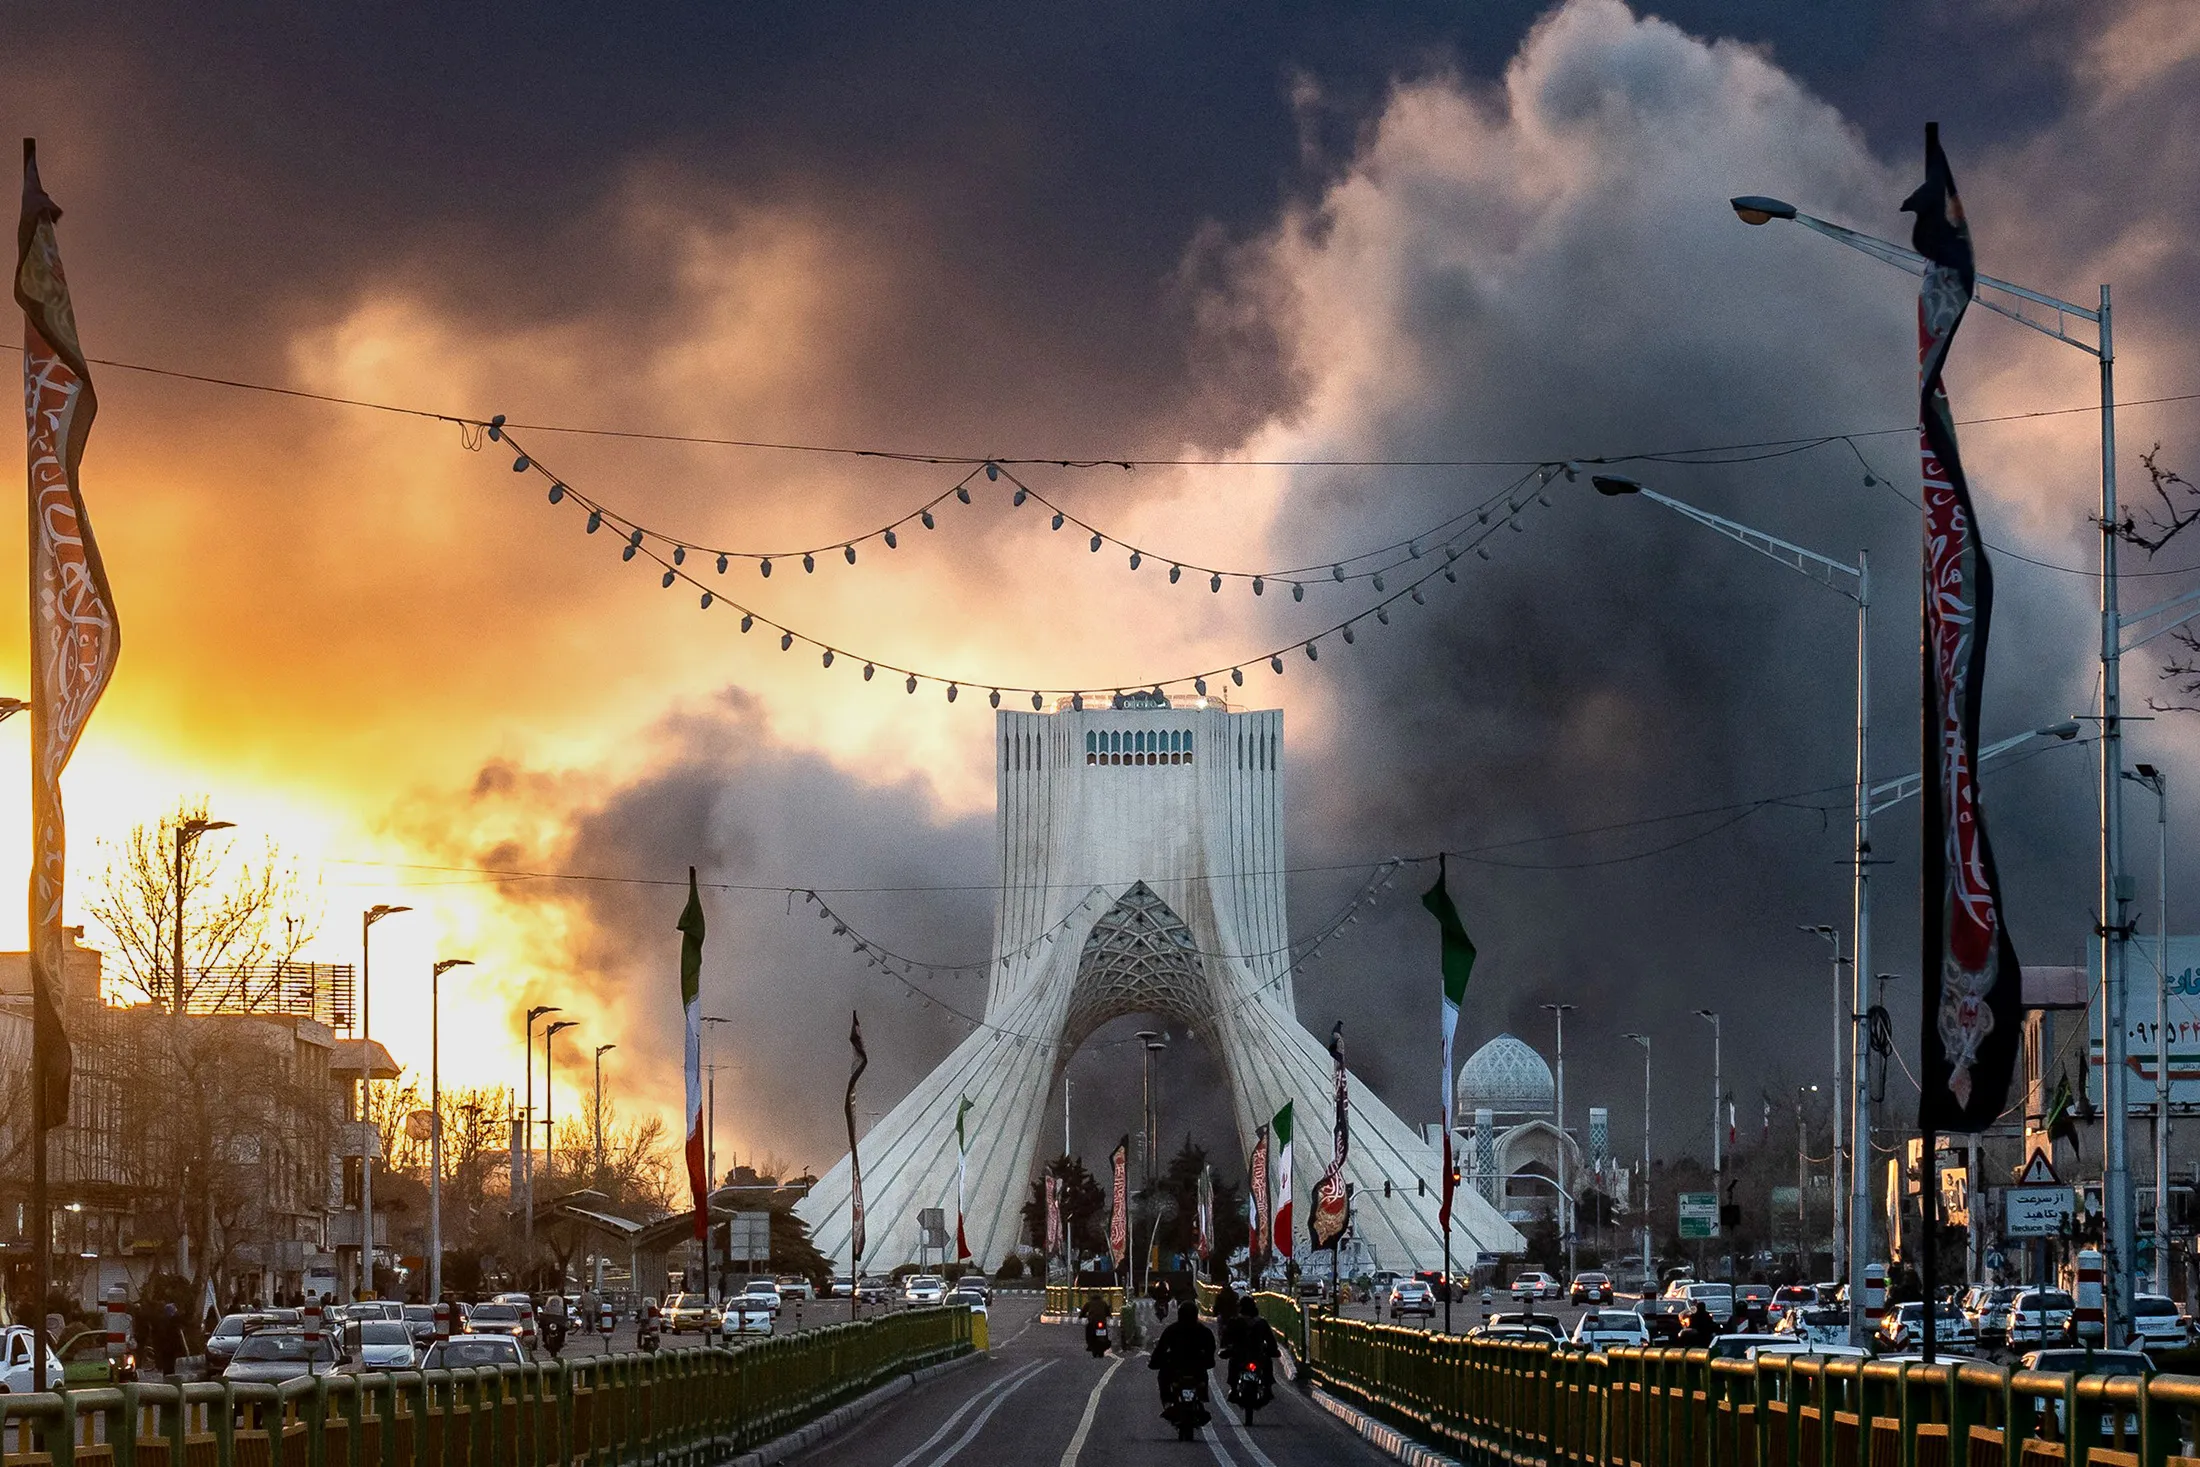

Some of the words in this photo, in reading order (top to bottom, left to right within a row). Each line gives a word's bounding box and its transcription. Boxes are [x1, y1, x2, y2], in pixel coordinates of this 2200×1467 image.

[2015, 1196, 2053, 1206] سرعت
[2053, 1193, 2064, 1205] از
[2023, 1209, 2058, 1221] بکاهید
[2011, 1224, 2043, 1232] Reduce
